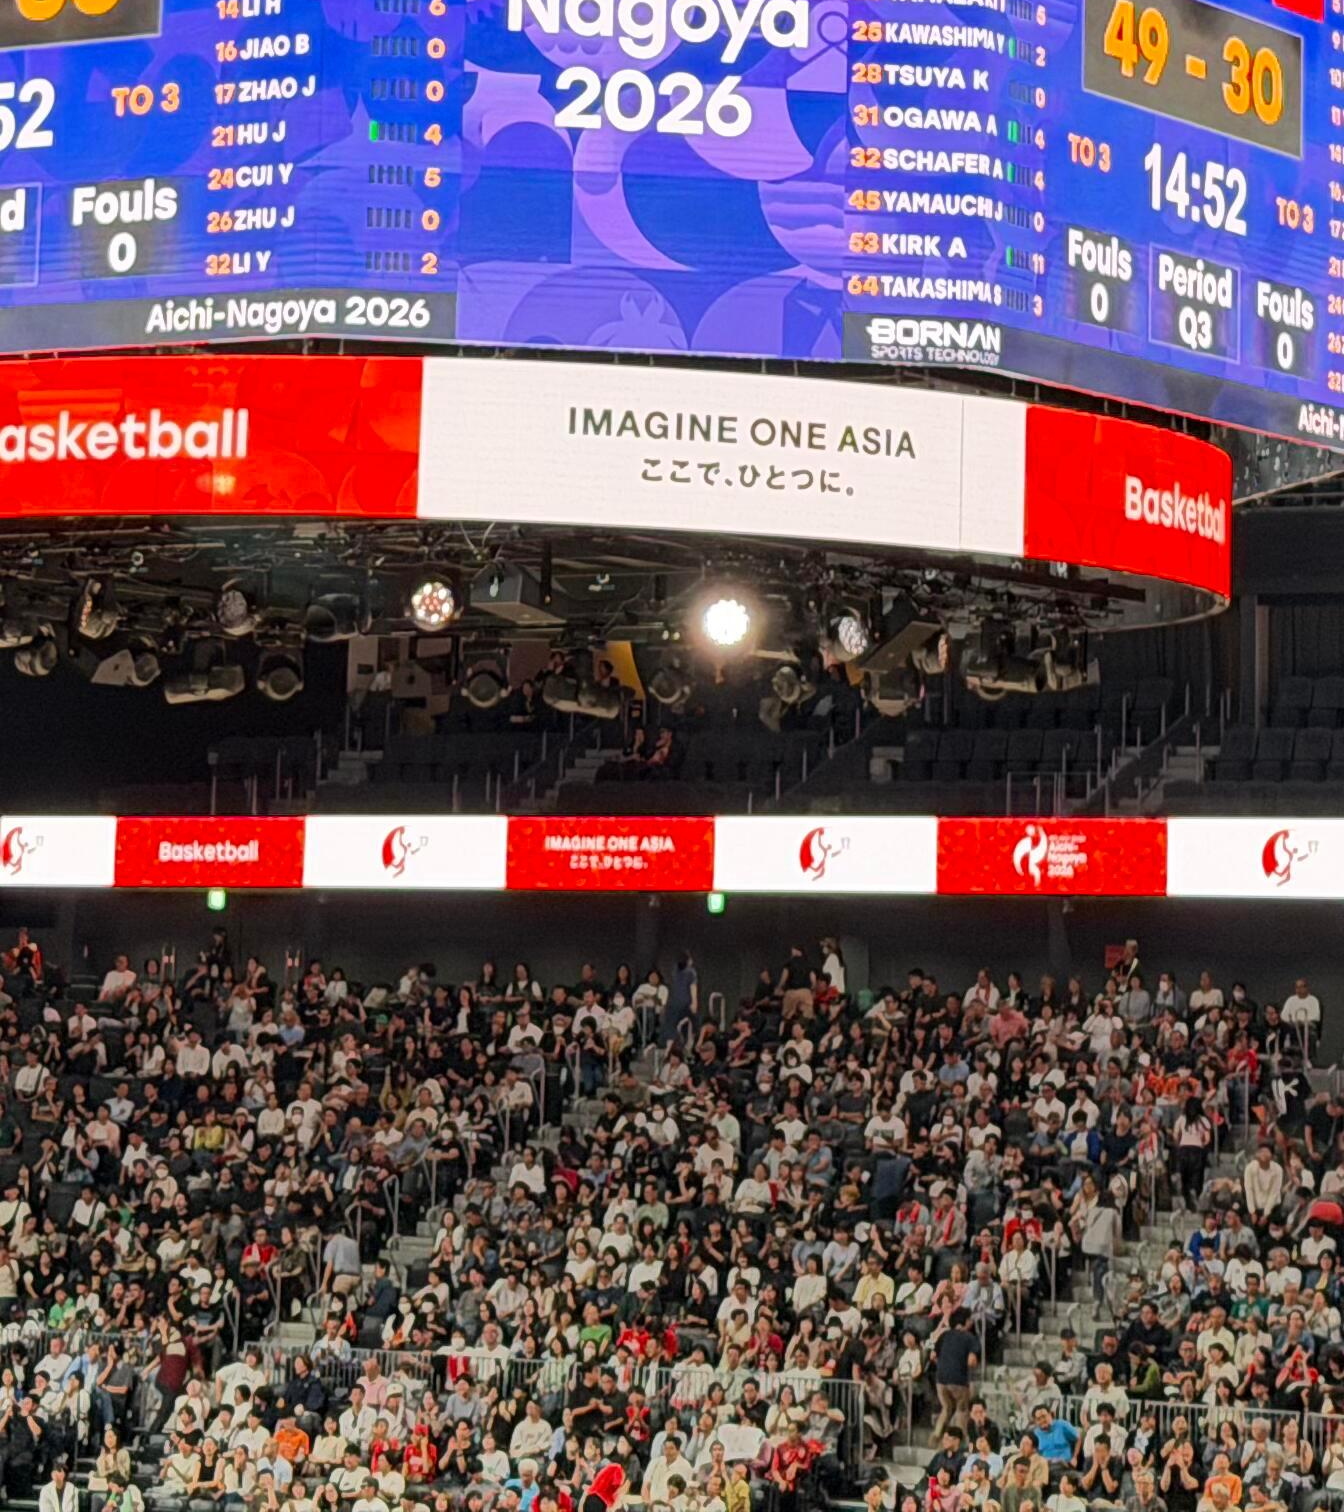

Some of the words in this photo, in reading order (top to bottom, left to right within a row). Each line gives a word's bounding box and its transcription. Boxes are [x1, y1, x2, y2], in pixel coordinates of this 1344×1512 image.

[216, 0, 239, 19] 14
[215, 41, 237, 62] 16
[240, 36, 290, 60] JIAO
[295, 34, 310, 55] B
[885, 22, 994, 51] KAWASHIMA
[214, 84, 234, 104] 17
[237, 78, 298, 103] ZHAO
[302, 76, 316, 97] J
[852, 63, 882, 84] 28
[884, 66, 965, 89] TSUYA
[972, 70, 989, 90] K
[1222, 36, 1283, 126] 30
[112, 86, 153, 115] TO
[161, 83, 180, 111] 3
[555, 66, 752, 137] 2026
[212, 126, 234, 147] 21
[237, 122, 268, 144] HU
[272, 120, 286, 142] J
[853, 104, 878, 126] 31
[883, 107, 981, 133] OGAWA
[986, 114, 998, 136] A
[850, 147, 881, 169] 32
[883, 149, 990, 173] SCHAFER
[993, 158, 1003, 179] A
[1068, 133, 1095, 167] TO
[1098, 144, 1110, 172] 3
[208, 169, 234, 190] 24
[236, 165, 274, 188] CUI
[278, 163, 293, 184] Y
[1144, 143, 1247, 236] 14:52
[72, 179, 177, 227] Fouls
[207, 211, 232, 232] 26
[233, 208, 277, 230] ZHU
[281, 206, 295, 227] J
[1277, 197, 1300, 229] TO
[1302, 205, 1314, 234] 3
[108, 233, 136, 272] 0
[849, 232, 879, 254] 53
[882, 234, 941, 256] KIRK
[948, 237, 967, 259] A
[205, 254, 230, 275] 32
[232, 253, 251, 274] LI
[255, 251, 271, 271] Y
[1068, 228, 1132, 281] Fouls
[1158, 254, 1232, 309] Period
[1257, 280, 1314, 330] Fouls
[848, 275, 878, 296] 64
[881, 276, 992, 303] TAKASHIMA
[146, 296, 337, 334] Aichi-Nagoya
[345, 296, 430, 328] 2026
[1090, 283, 1109, 322] 0
[1178, 307, 1212, 350] Q3
[1277, 333, 1294, 369] 0
[866, 318, 1000, 353] BORNAN
[871, 345, 923, 360] SPORTS
[568, 406, 738, 443] IMAGINE
[750, 418, 827, 451] ONE
[837, 425, 918, 460] ASIA
[641, 458, 854, 496] ここで、ひとつに。
[158, 840, 259, 863] Basketball
[544, 835, 605, 851] IMAGINE
[607, 836, 639, 852] ONE
[640, 836, 675, 852] ASIA
